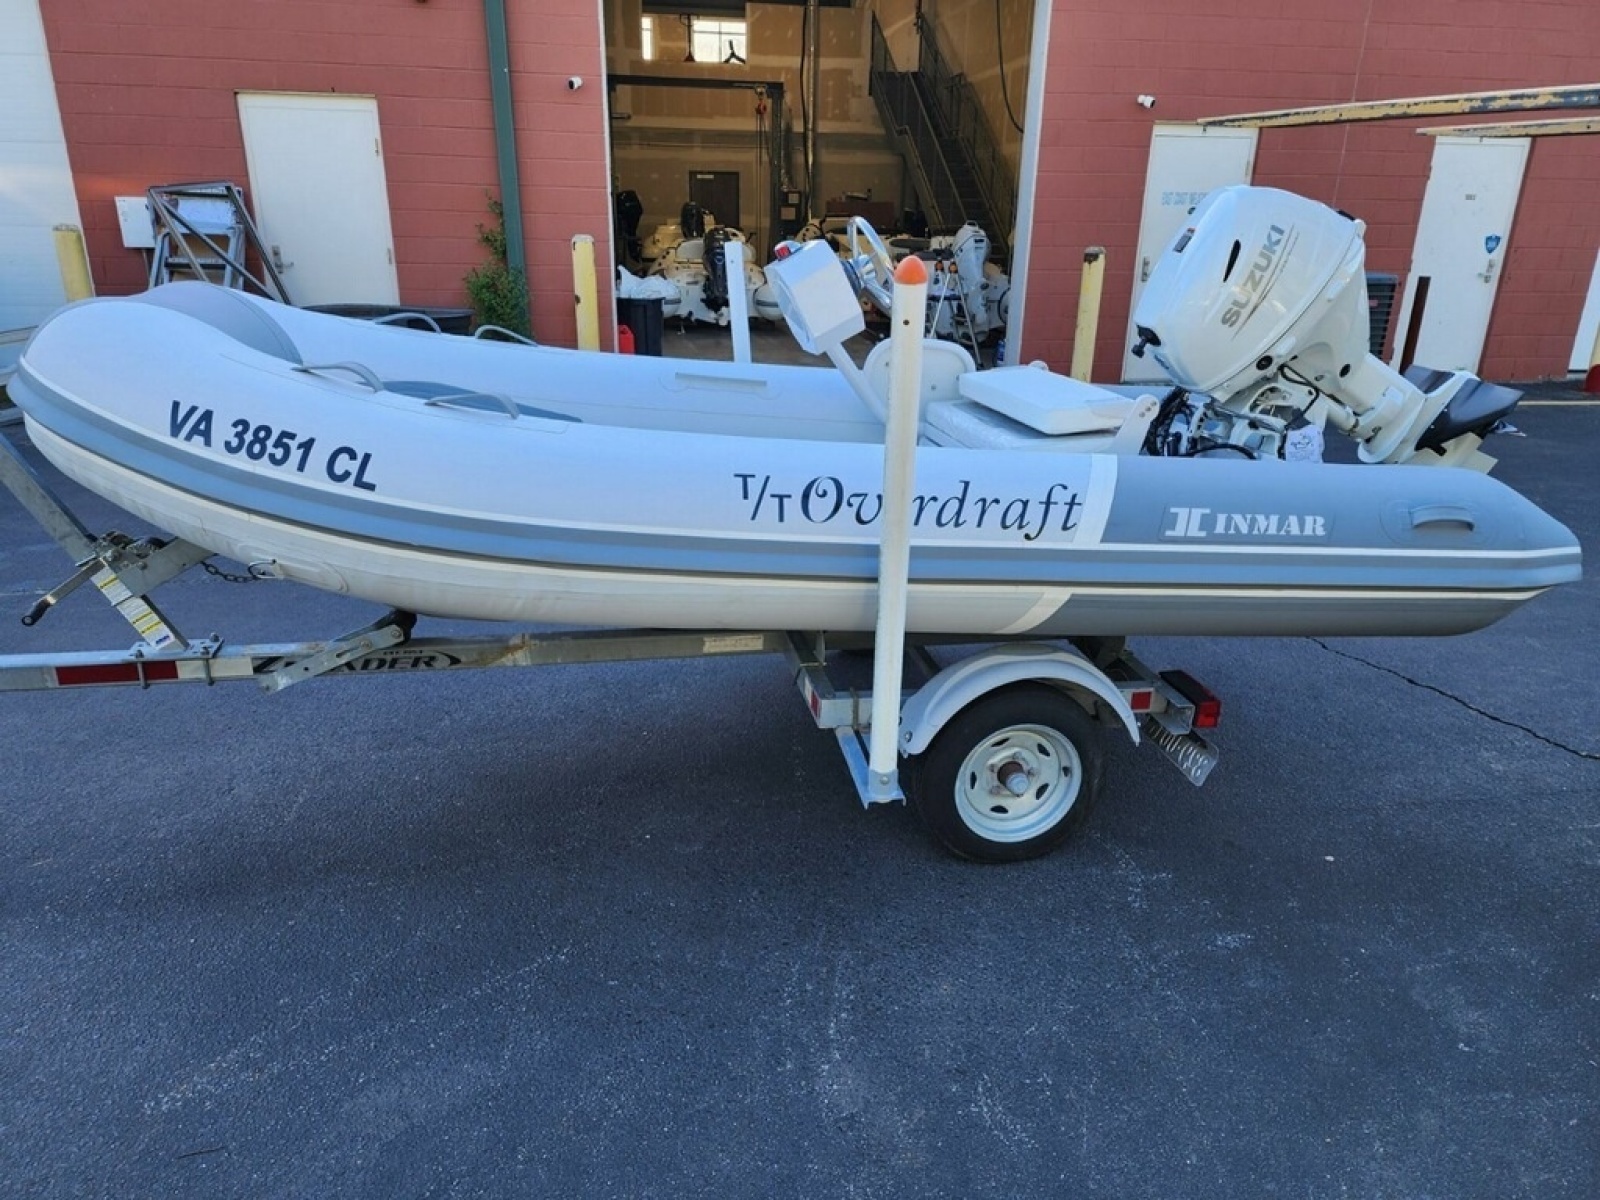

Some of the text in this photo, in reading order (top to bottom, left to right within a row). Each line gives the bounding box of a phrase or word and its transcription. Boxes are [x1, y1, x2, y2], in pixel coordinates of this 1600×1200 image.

[1221, 224, 1285, 328] SUZUKI
[169, 399, 377, 492] VA 3851 CL
[734, 473, 1083, 541] T/T Ovrdraft
[1213, 513, 1327, 537] INMAR
